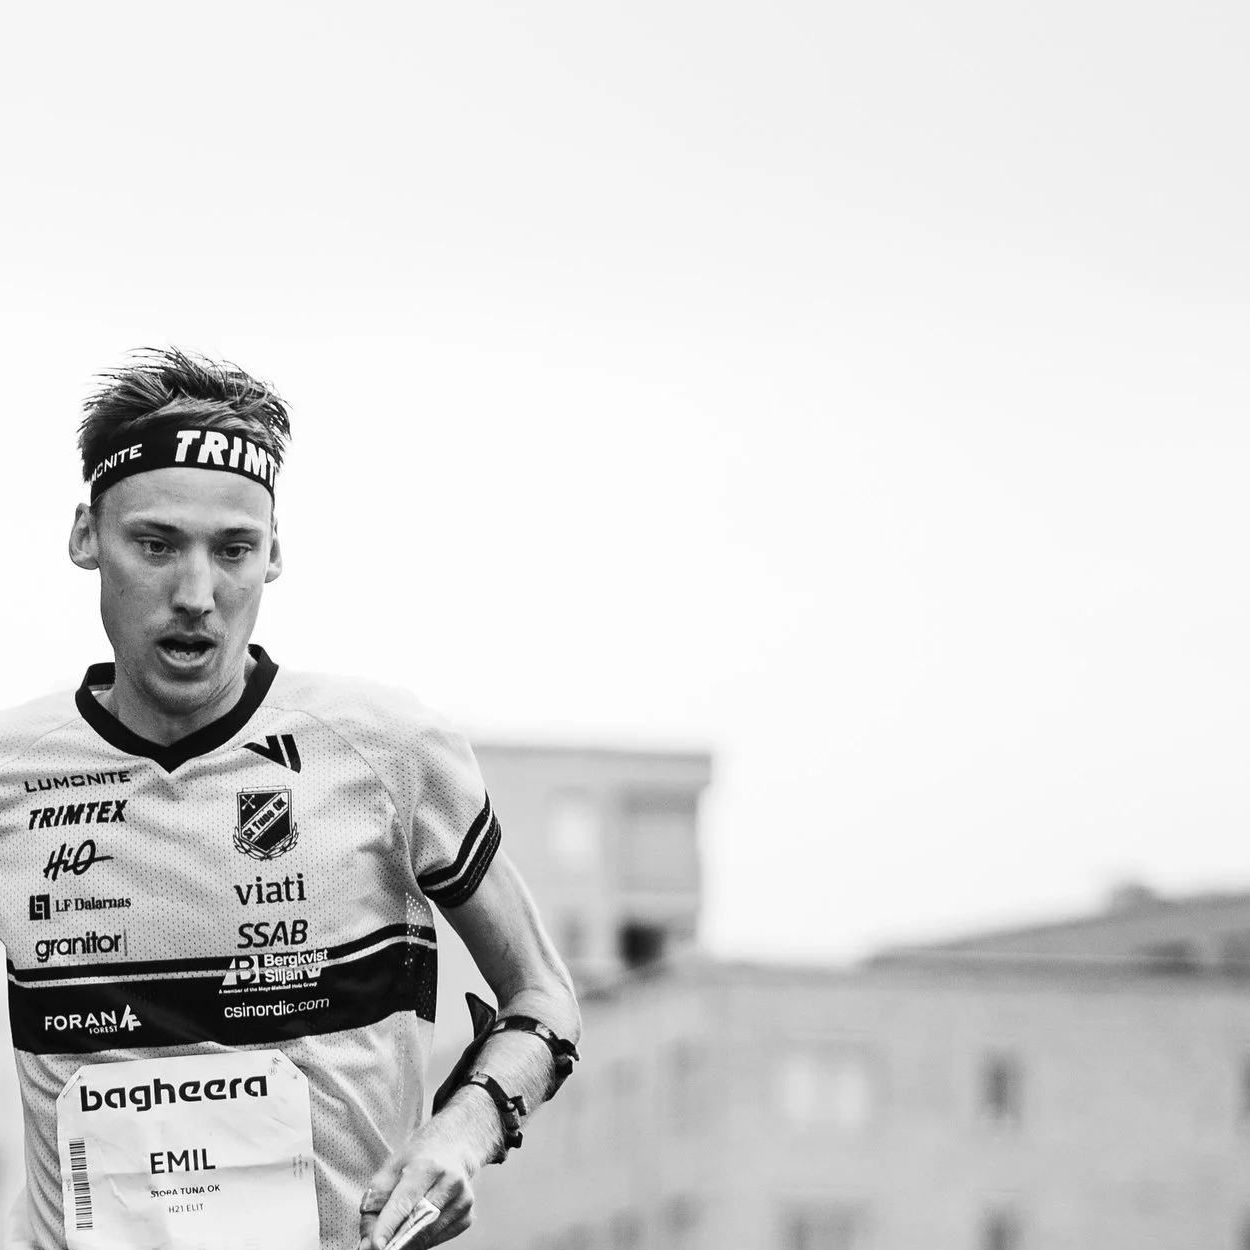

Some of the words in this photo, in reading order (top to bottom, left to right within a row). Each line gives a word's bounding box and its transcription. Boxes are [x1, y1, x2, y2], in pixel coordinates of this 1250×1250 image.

[24, 770, 131, 793] LUMONITE
[28, 799, 128, 830] TRIMTEX
[43, 839, 114, 881] HiQ
[233, 872, 307, 906] viati
[55, 899, 72, 912] LF
[74, 896, 132, 911] Dalarnas
[237, 919, 309, 949] SSAB
[35, 931, 122, 963] granitor
[263, 949, 329, 968] Bergkvist
[264, 967, 304, 985] Siljan
[224, 998, 330, 1018] csinordic.com
[44, 1010, 117, 1032] FORAN
[80, 1075, 268, 1112] bagheera
[150, 1148, 216, 1175] EMIL
[180, 1186, 205, 1196] TUNA
[207, 1184, 221, 1193] OK
[168, 1204, 184, 1214] H21
[186, 1203, 204, 1213] ELIT
